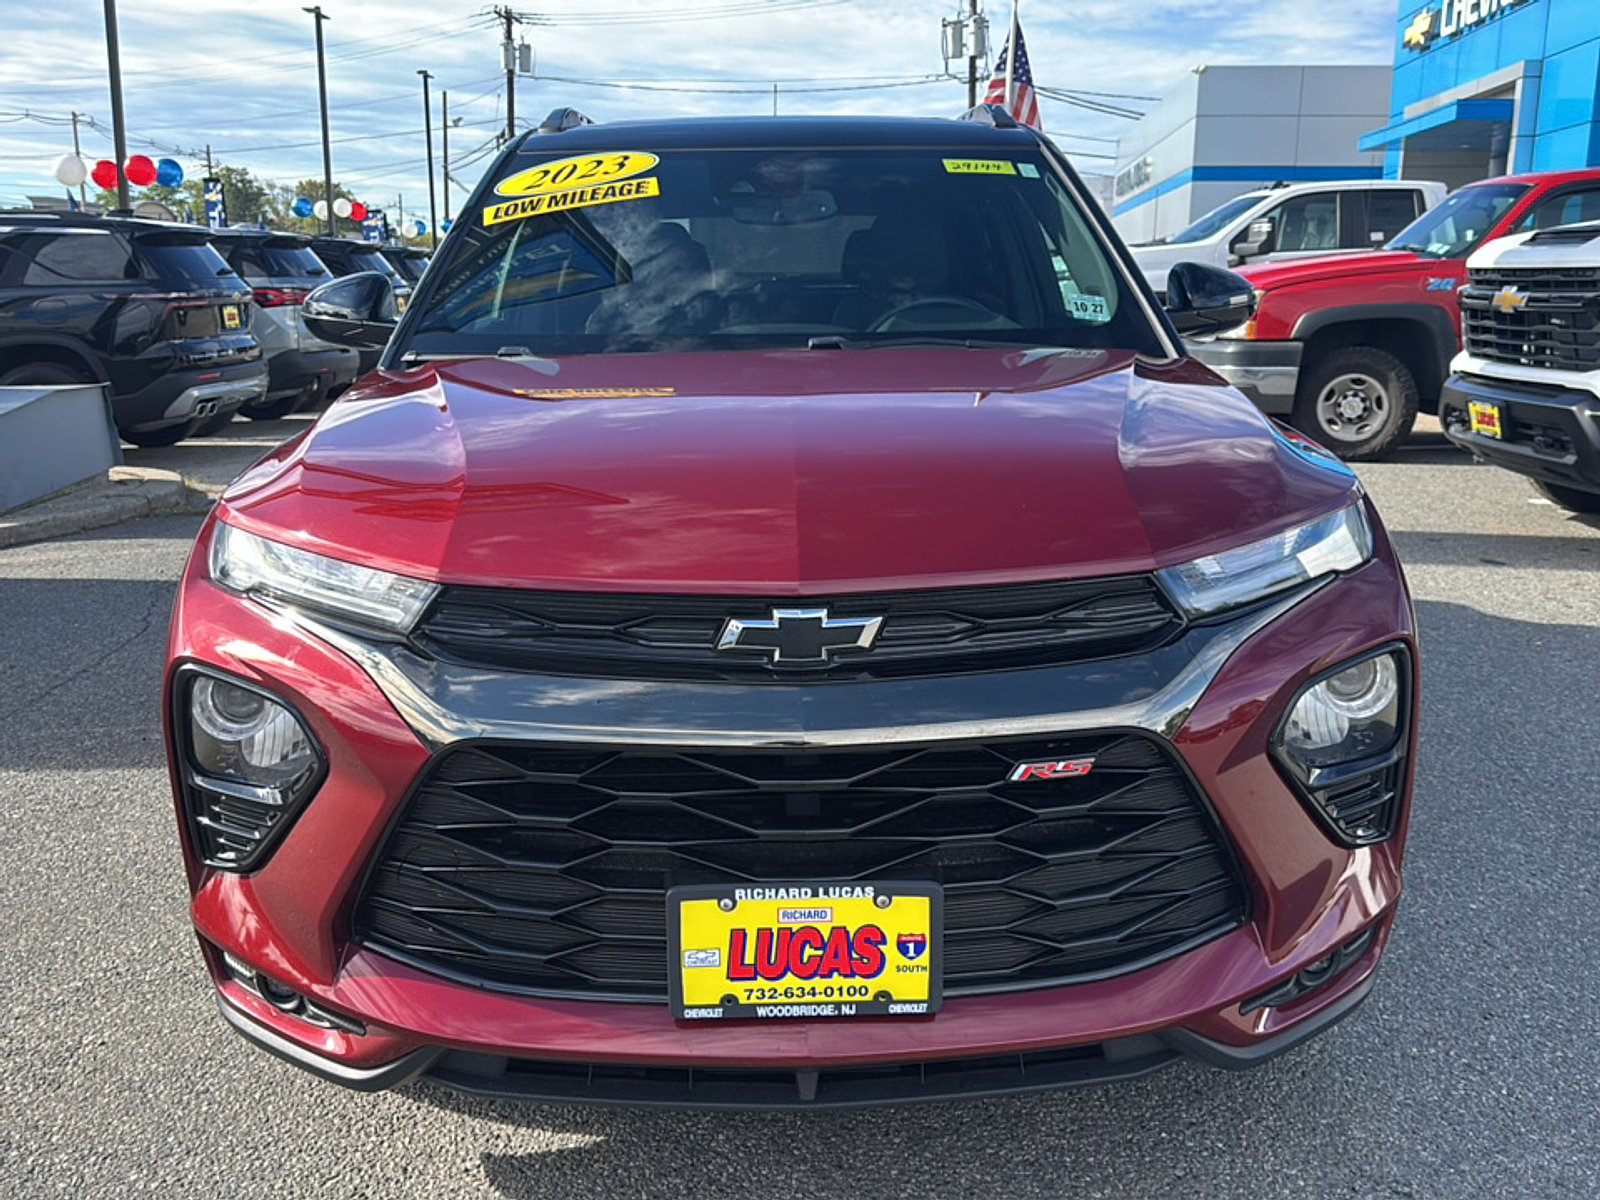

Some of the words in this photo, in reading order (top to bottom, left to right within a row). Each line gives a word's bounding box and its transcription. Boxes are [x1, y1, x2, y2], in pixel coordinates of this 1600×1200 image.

[523, 155, 631, 191] 2023
[493, 198, 545, 220] LOW
[547, 181, 651, 209] MILEAGE
[1073, 302, 1088, 313] 10
[1010, 757, 1096, 781] RS
[735, 888, 813, 901] RICHARD
[818, 886, 875, 899] LUCAS
[781, 909, 828, 921] RICHARD
[726, 923, 888, 982] LUCAS
[906, 942, 917, 957] 1
[896, 964, 928, 973] SOUTH
[743, 985, 870, 1001] 732-634-0100
[684, 1008, 724, 1018] CHEVROLET
[841, 1004, 857, 1015] NJ
[888, 1003, 928, 1014] CHEVROLET
